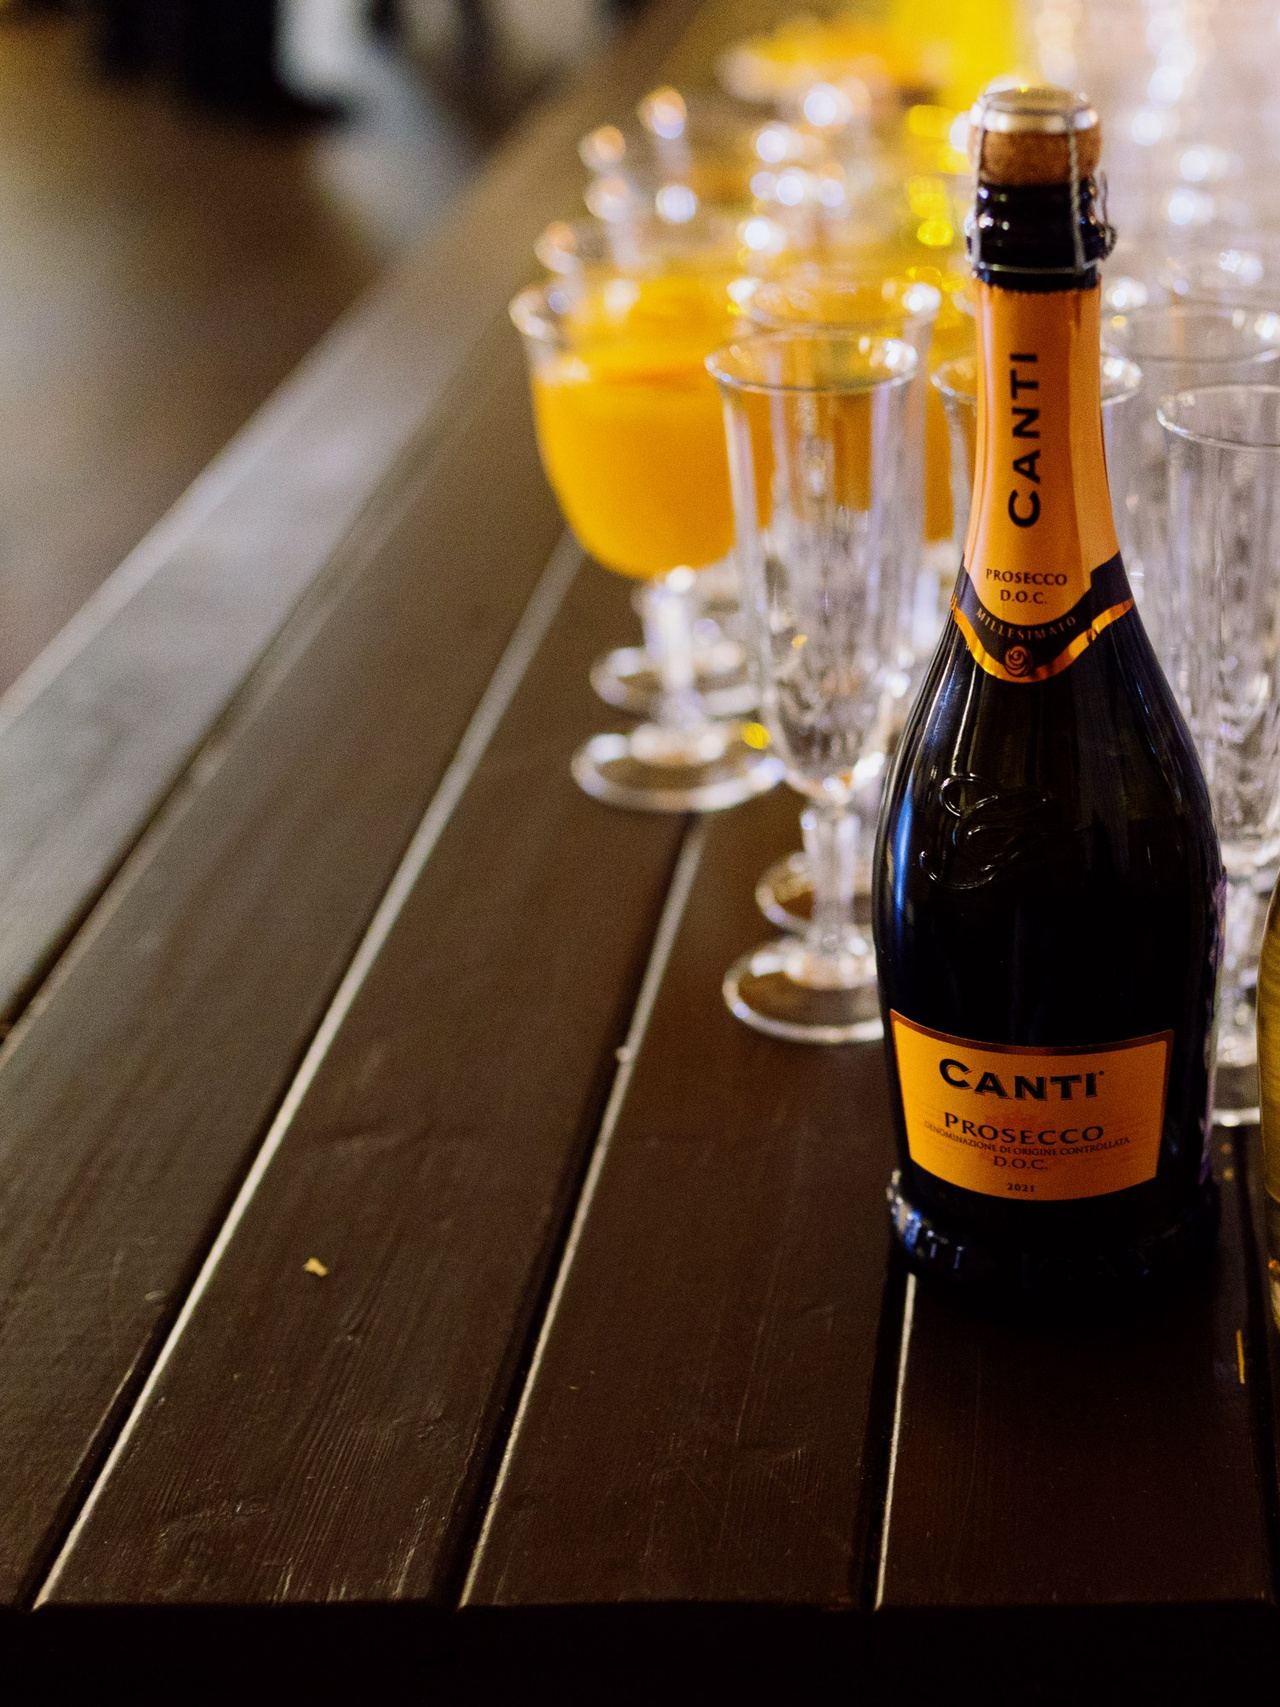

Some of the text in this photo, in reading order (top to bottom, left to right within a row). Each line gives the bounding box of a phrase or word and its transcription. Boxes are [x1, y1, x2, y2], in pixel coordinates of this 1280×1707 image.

[1008, 353, 1041, 528] CANTI
[985, 568, 1068, 587] PROSECCO
[999, 590, 1048, 605] D.O.C.
[975, 607, 1077, 641] MILLESIMATO
[939, 1058, 1099, 1101] CANTI
[923, 1119, 1131, 1157] DENOMINAZIONE DI ORIGINE CONTROLLATA
[943, 1111, 1105, 1146] PROSECCO
[993, 1155, 1049, 1171] D.O.C.
[1006, 1182, 1035, 1193] 2021
